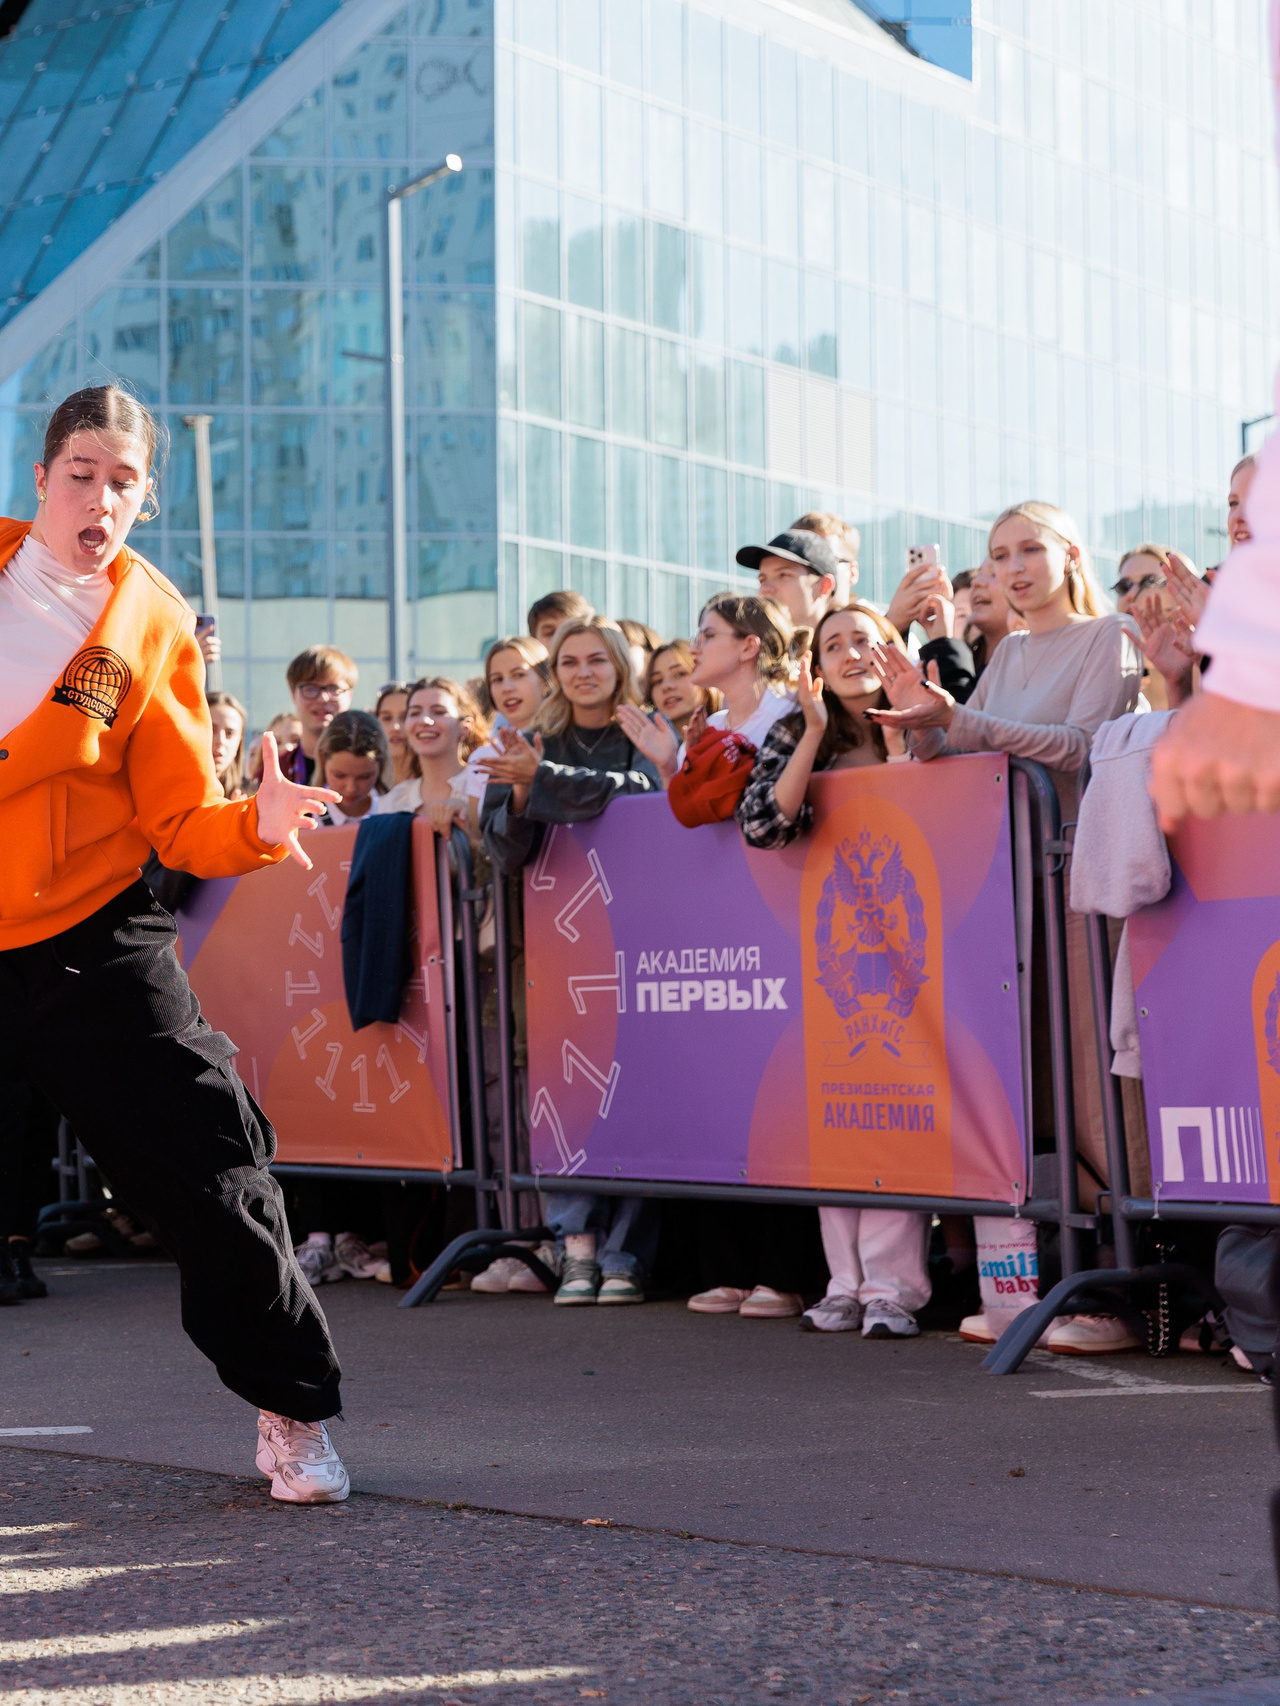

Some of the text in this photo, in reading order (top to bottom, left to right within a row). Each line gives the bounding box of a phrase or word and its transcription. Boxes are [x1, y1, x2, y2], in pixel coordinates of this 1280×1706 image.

[67, 690, 113, 717] СТУДСОВЕТ
[636, 946, 761, 976] АКАДЕМИЯ
[636, 977, 788, 1013] ПЕРВЫХ
[844, 1013, 905, 1043] РАНХиГС
[821, 1082, 935, 1097] ПРЕЗИДЕНТСКАЯ
[823, 1101, 935, 1132] АКАДЕМИЯ
